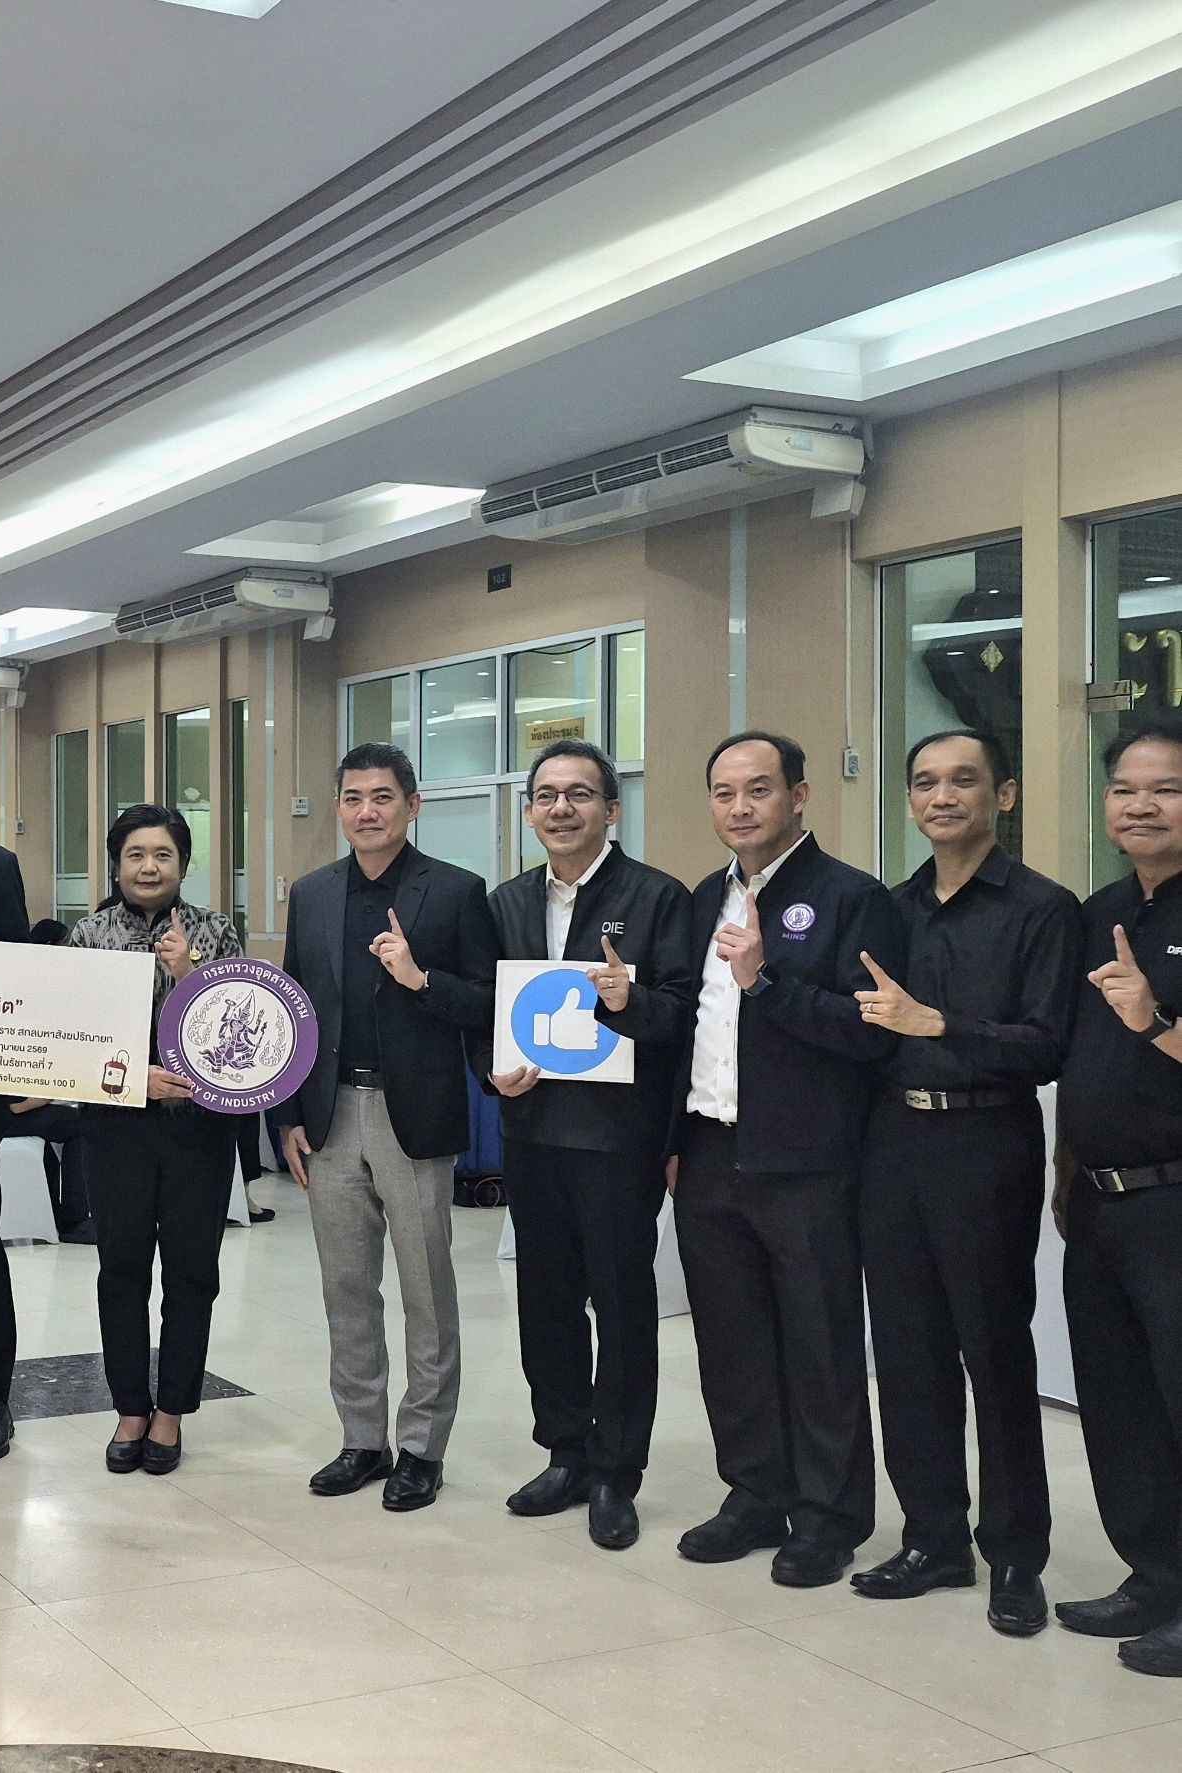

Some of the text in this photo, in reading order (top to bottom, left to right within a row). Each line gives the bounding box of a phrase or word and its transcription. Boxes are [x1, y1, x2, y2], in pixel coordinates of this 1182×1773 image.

[601, 921, 625, 935] OIE
[781, 932, 807, 941] MIND
[202, 963, 310, 1019] กระทรวงอุตสาหกรรม
[27, 1045, 48, 1054] 2569
[0, 1055, 45, 1070] ในรัชกาลที่
[47, 1061, 54, 1070] 7
[52, 1079, 68, 1088] 100
[202, 1091, 219, 1103] OF
[220, 1089, 276, 1108] INDUSTRY
